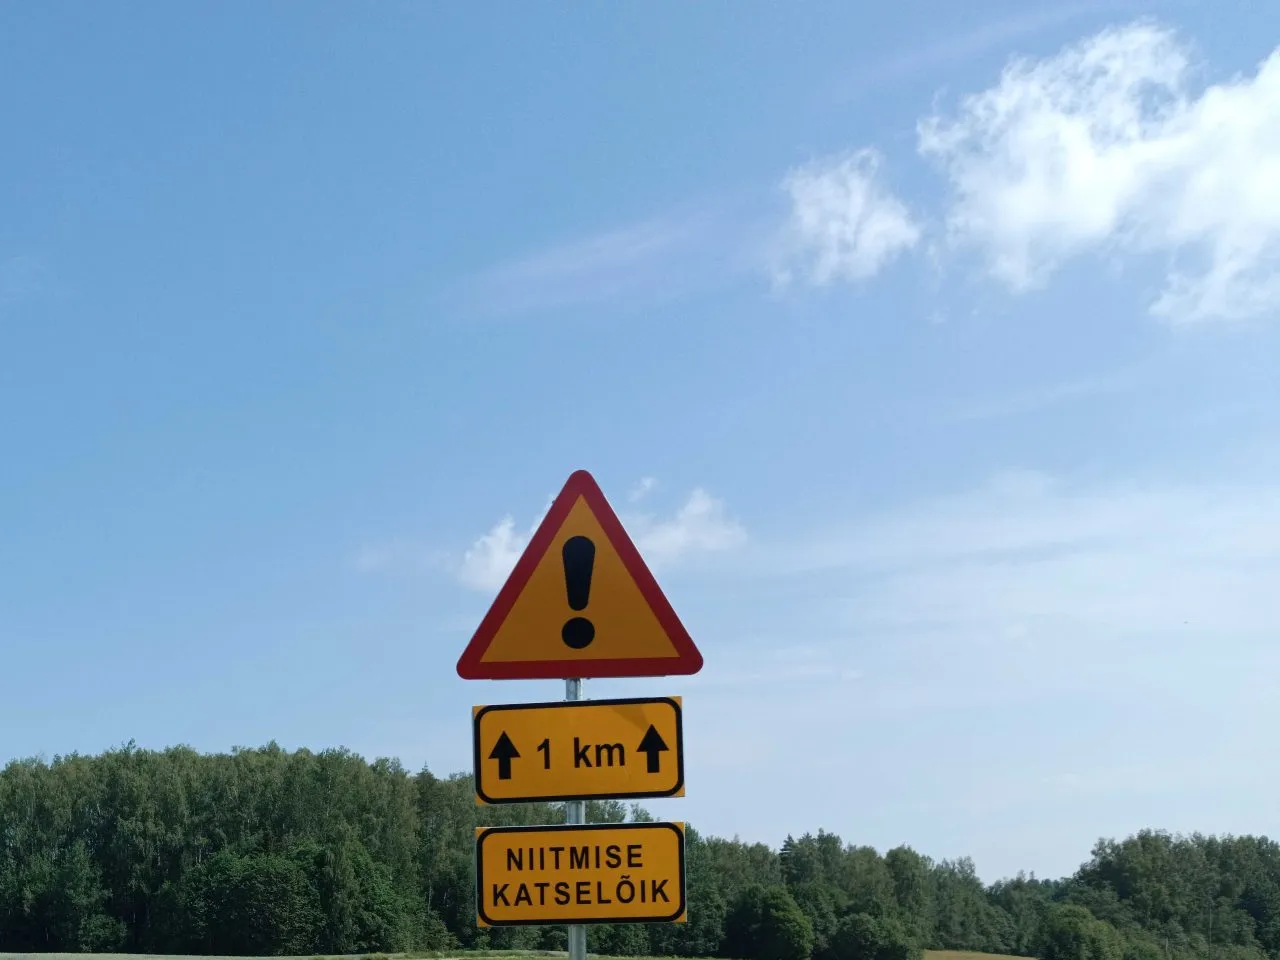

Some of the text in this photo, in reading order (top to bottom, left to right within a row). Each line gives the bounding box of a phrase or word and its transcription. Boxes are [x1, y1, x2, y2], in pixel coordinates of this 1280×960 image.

[537, 737, 626, 769] 1 km
[506, 844, 644, 871] NIITMISE
[492, 875, 671, 907] KATSELÕIK
